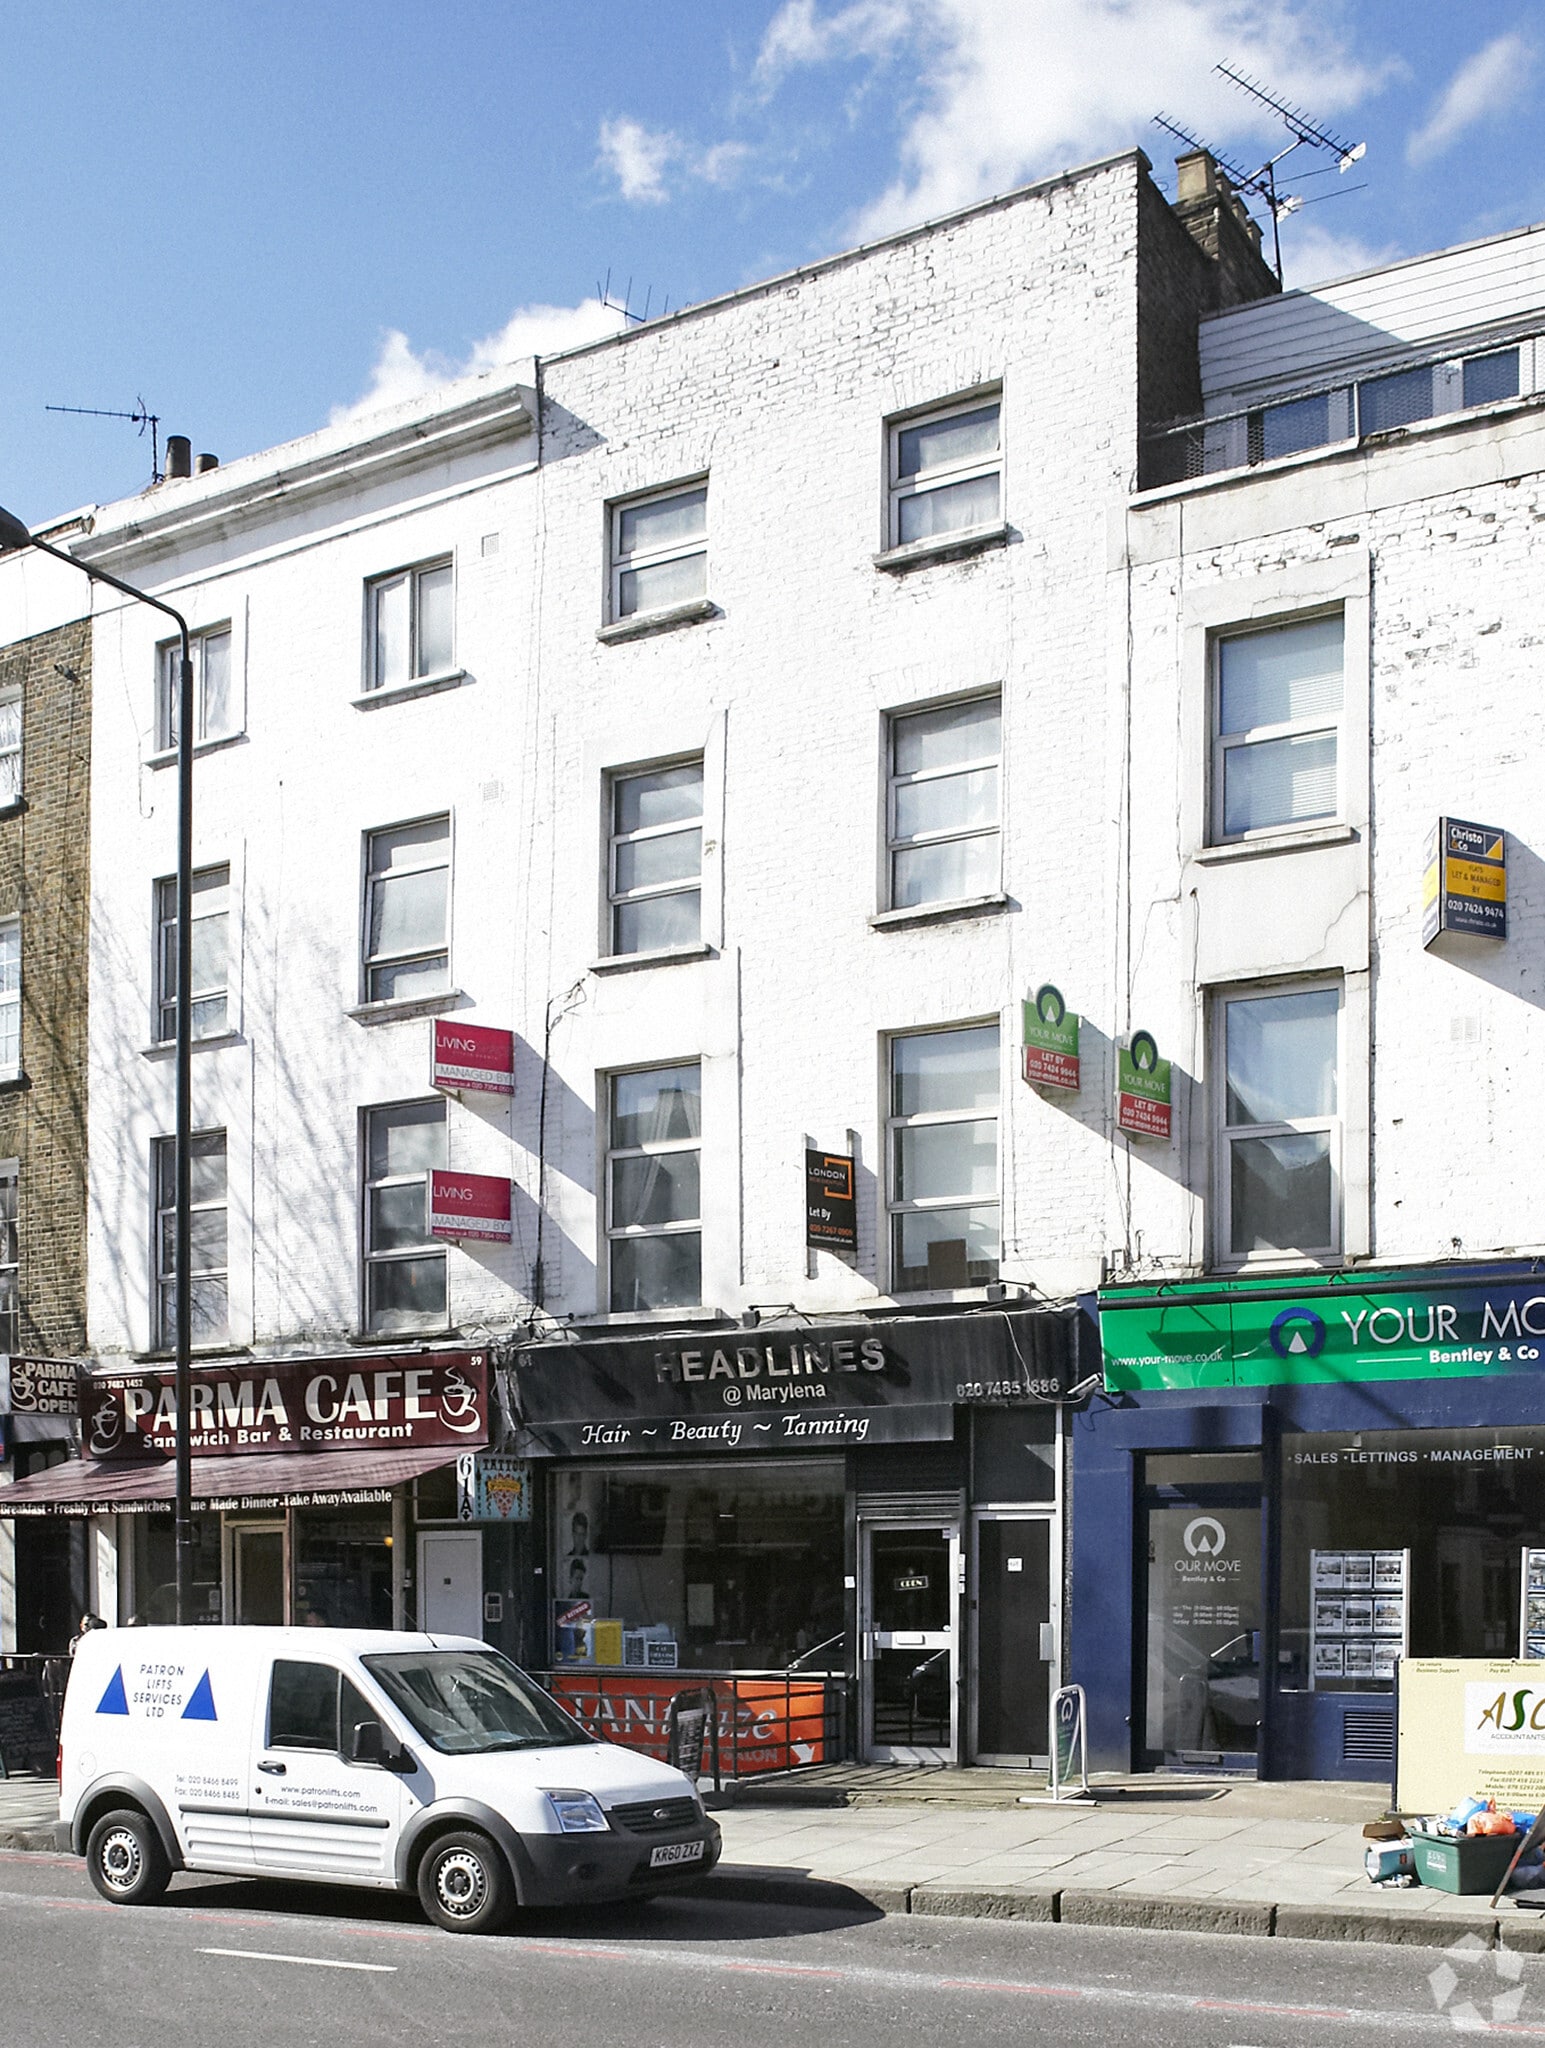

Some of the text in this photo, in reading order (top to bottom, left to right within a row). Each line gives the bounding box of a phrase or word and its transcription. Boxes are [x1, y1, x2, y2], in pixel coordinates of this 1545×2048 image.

[1450, 828, 1483, 844] Christo
[1452, 871, 1462, 879] LET
[1472, 885, 1480, 893] BY
[1448, 900, 1504, 918] 020 7424 9474
[436, 1035, 476, 1052] LIVING
[1029, 1027, 1074, 1046] YOUR MOVE
[1042, 1052, 1065, 1065] LET BY
[440, 1066, 510, 1083] MANAGED BY
[1122, 1074, 1166, 1093] YOUR MOVE
[1134, 1099, 1157, 1112] LET BY
[809, 1168, 846, 1180] LONDON
[433, 1186, 473, 1200] LIVING
[809, 1207, 831, 1221] Let By
[435, 1215, 507, 1231] MANAGED BY
[1341, 1304, 1459, 1345] YOUR
[471, 1356, 482, 1366] 59
[654, 1338, 887, 1383] HEADLINES
[1111, 1351, 1223, 1367] www.your-move.co.uk
[1429, 1345, 1539, 1365] Bentley & Co
[24, 1362, 77, 1379] PARMA
[37, 1380, 77, 1397] CAFE
[723, 1382, 827, 1406] @ Marylena
[956, 1382, 983, 1397] 020
[985, 1380, 1021, 1395] 7485
[38, 1399, 78, 1414] OPEN
[124, 1369, 437, 1433] PARMA CAFE
[143, 1422, 413, 1448] Sanwich Bar & Restaurant
[580, 1413, 870, 1446] Hair Beauty Tanning
[1294, 1448, 1534, 1464] SALES LETTINGS MANAGEMENT
[483, 1459, 525, 1472] TATTOO
[54, 1503, 89, 1516] Freshly
[91, 1502, 109, 1513] Cut
[111, 1500, 171, 1514] Sandwiches
[209, 1498, 238, 1511] Made
[1204, 1560, 1241, 1572] MOVE
[1182, 1575, 1208, 1583] Bentley
[140, 1664, 185, 1676] PATRON
[147, 1679, 172, 1690] LIFTS
[133, 1692, 182, 1705] SERVICES
[146, 1706, 165, 1718] LTD
[188, 1775, 201, 1784] 020
[189, 1788, 202, 1797] 020
[281, 1786, 361, 1798] www.patronlifts.com
[291, 1799, 378, 1812] sales@patronlifts.com
[654, 1842, 700, 1863] KR60 ZXZ
